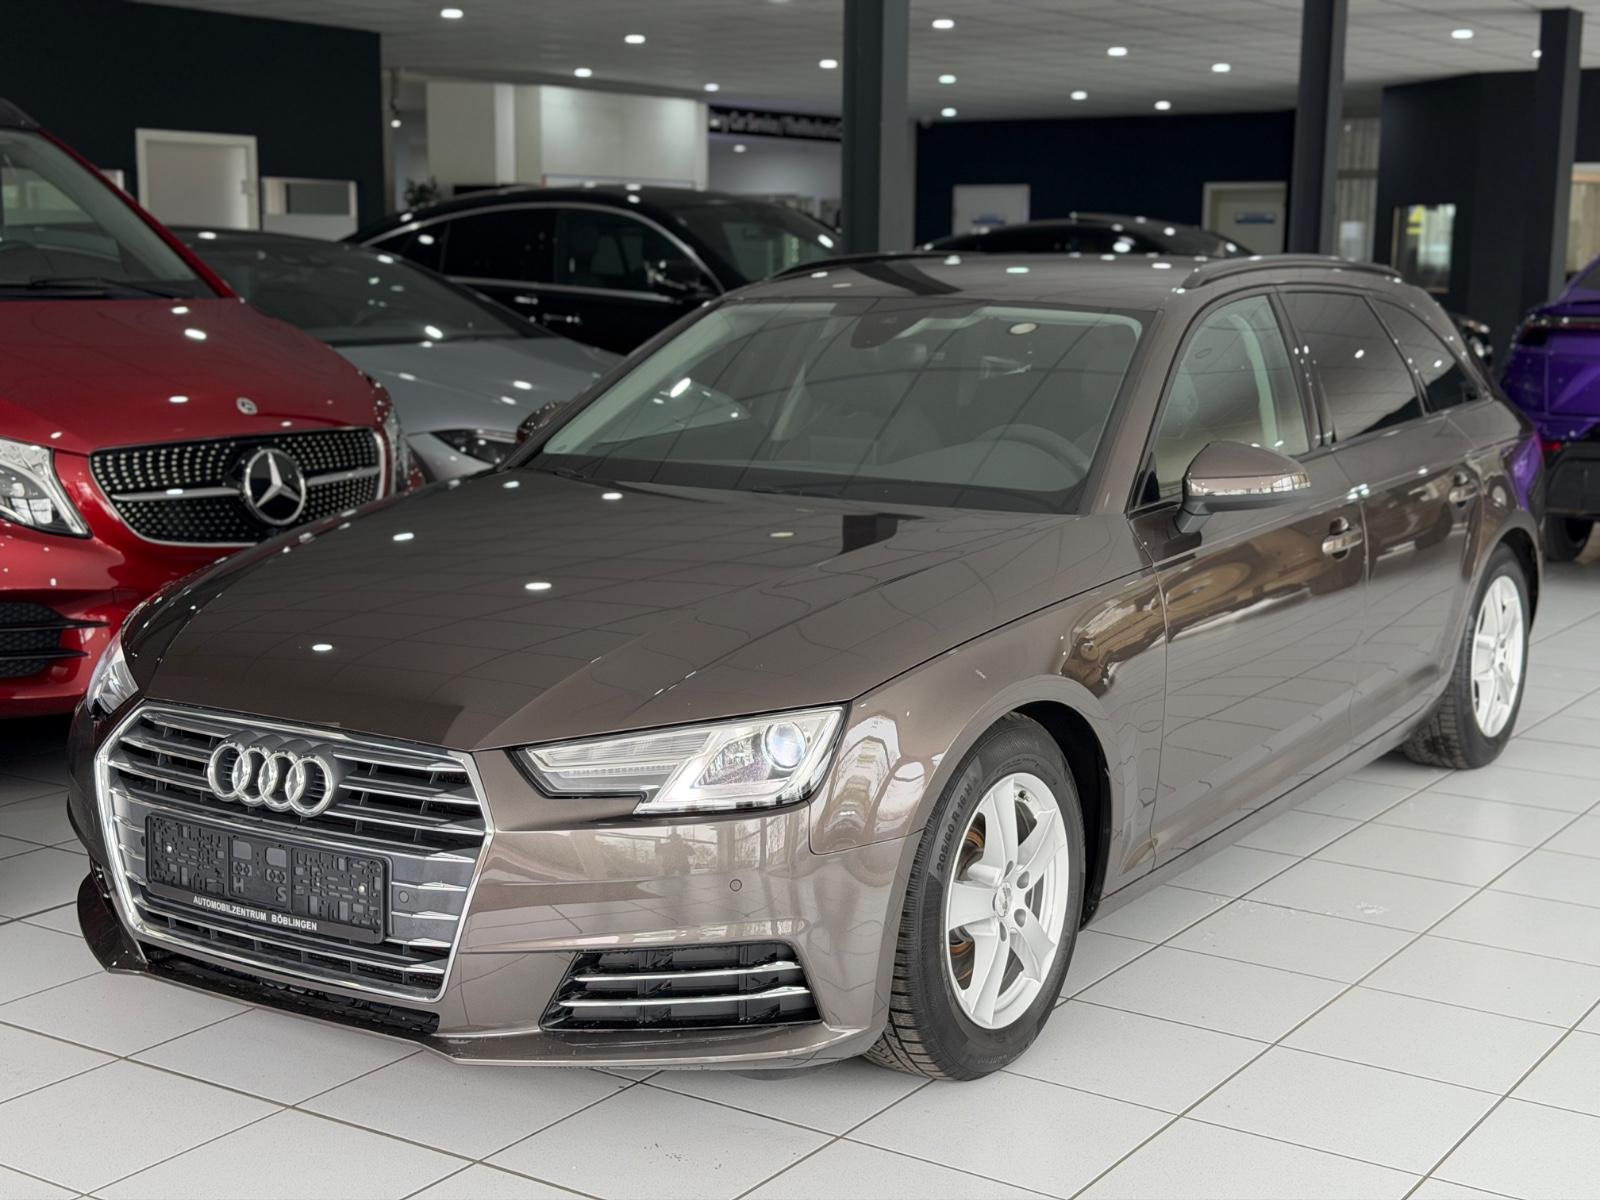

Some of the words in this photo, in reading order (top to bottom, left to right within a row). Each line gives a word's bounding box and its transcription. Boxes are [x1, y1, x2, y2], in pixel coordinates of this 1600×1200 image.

[936, 823, 955, 872] 205/60
[951, 811, 960, 822] R
[276, 886, 287, 902] S
[193, 895, 267, 921] AUTOMOBILZENTRUM
[271, 914, 318, 931] BÖBLINGEN
